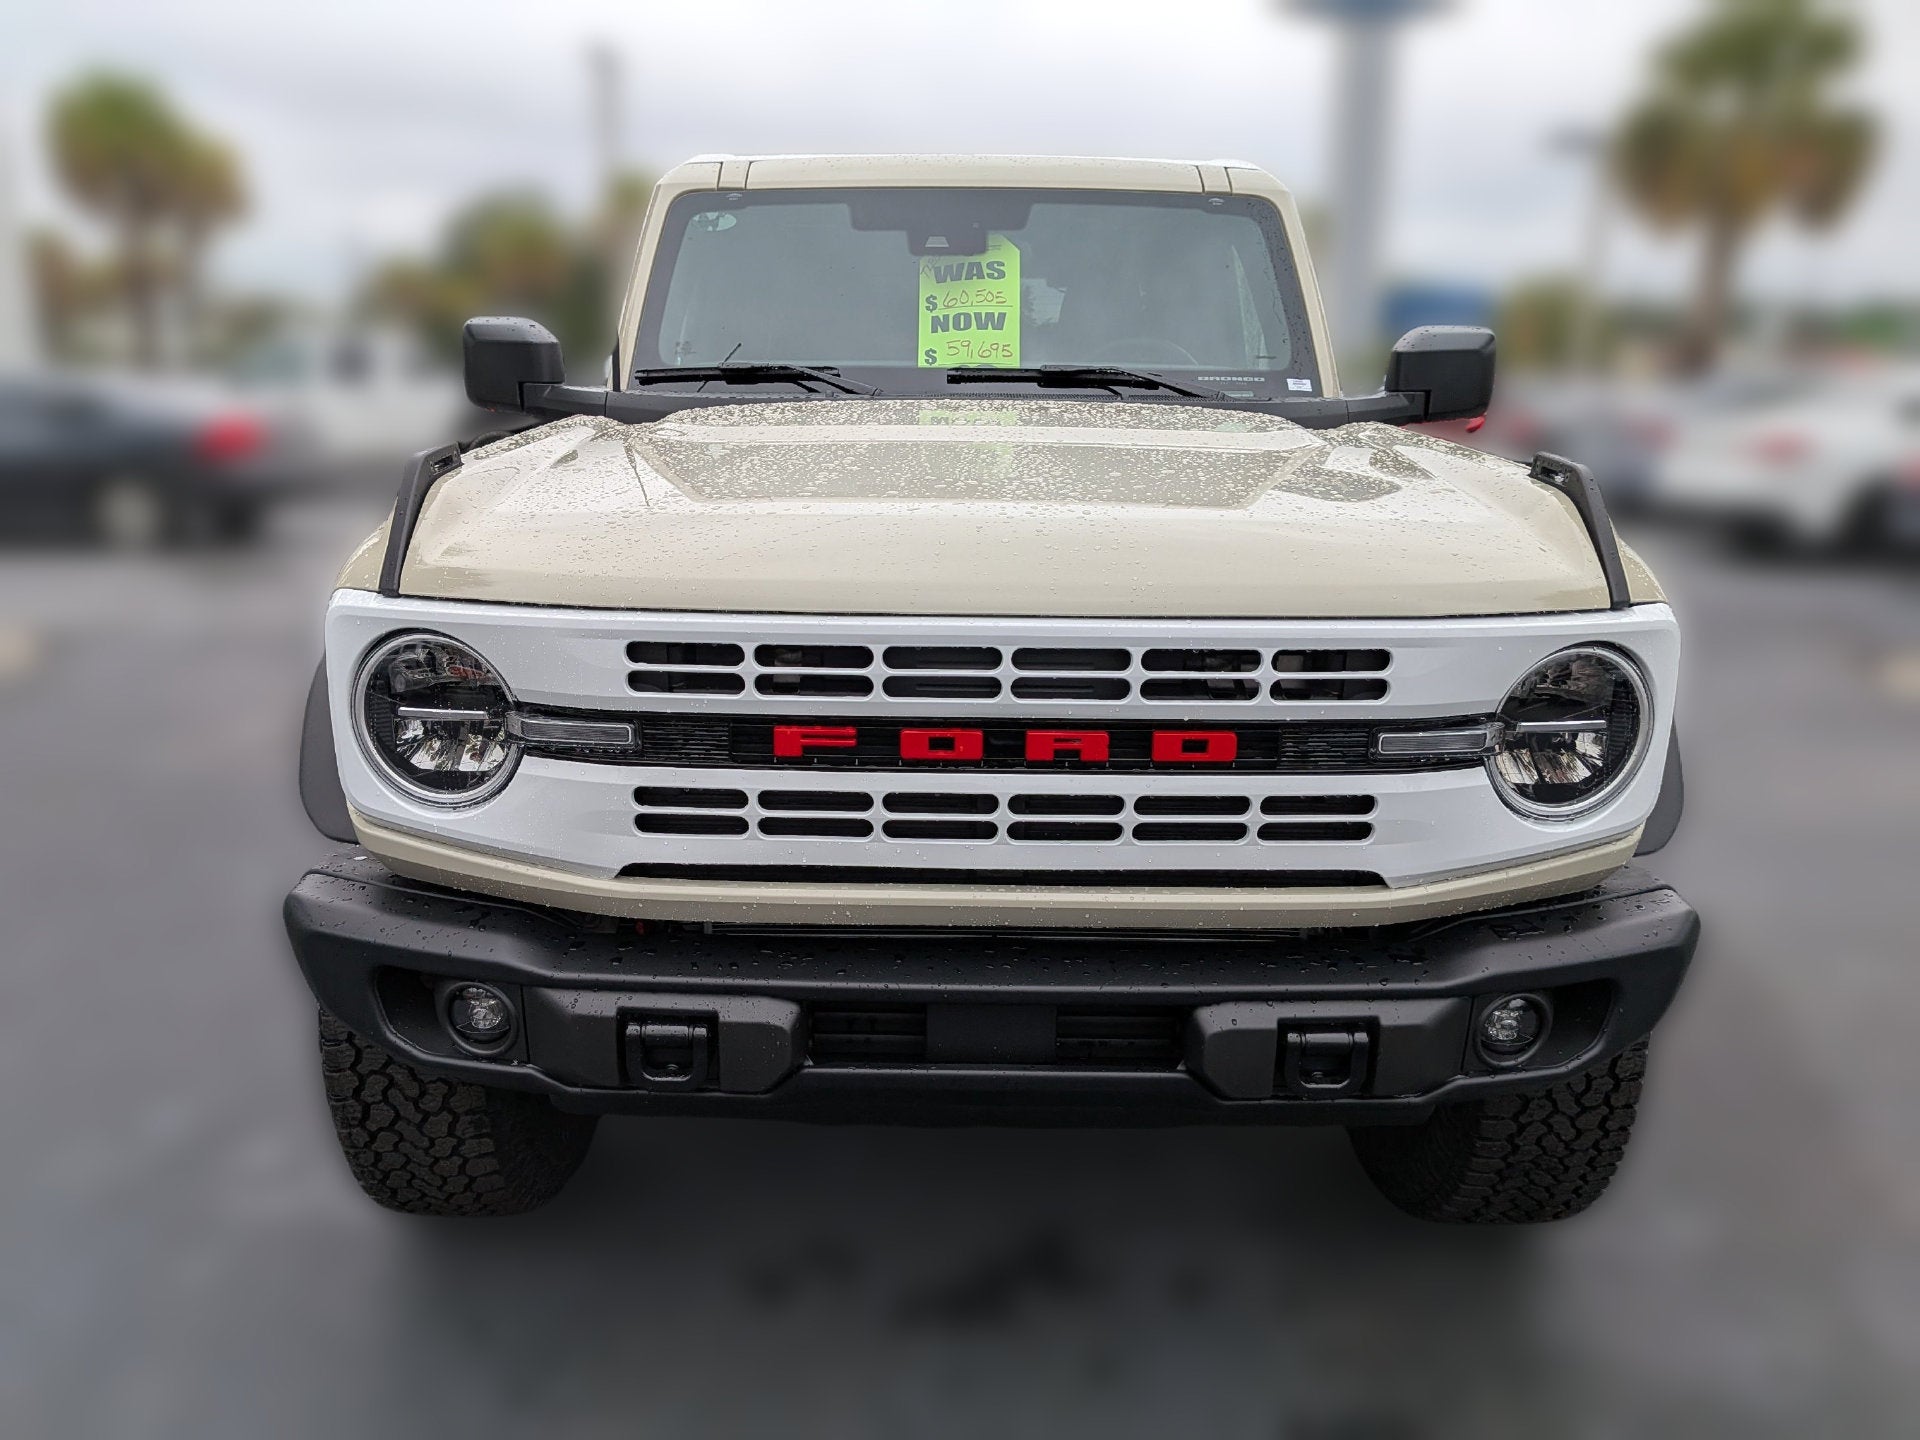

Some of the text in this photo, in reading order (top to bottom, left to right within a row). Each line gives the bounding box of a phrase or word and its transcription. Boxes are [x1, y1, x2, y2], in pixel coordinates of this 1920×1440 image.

[934, 261, 1006, 283] WAS
[925, 289, 1007, 313] $ 60,505
[930, 312, 1007, 334] NOW
[924, 340, 1013, 366] $ 59,695
[773, 726, 1237, 762] FORD
